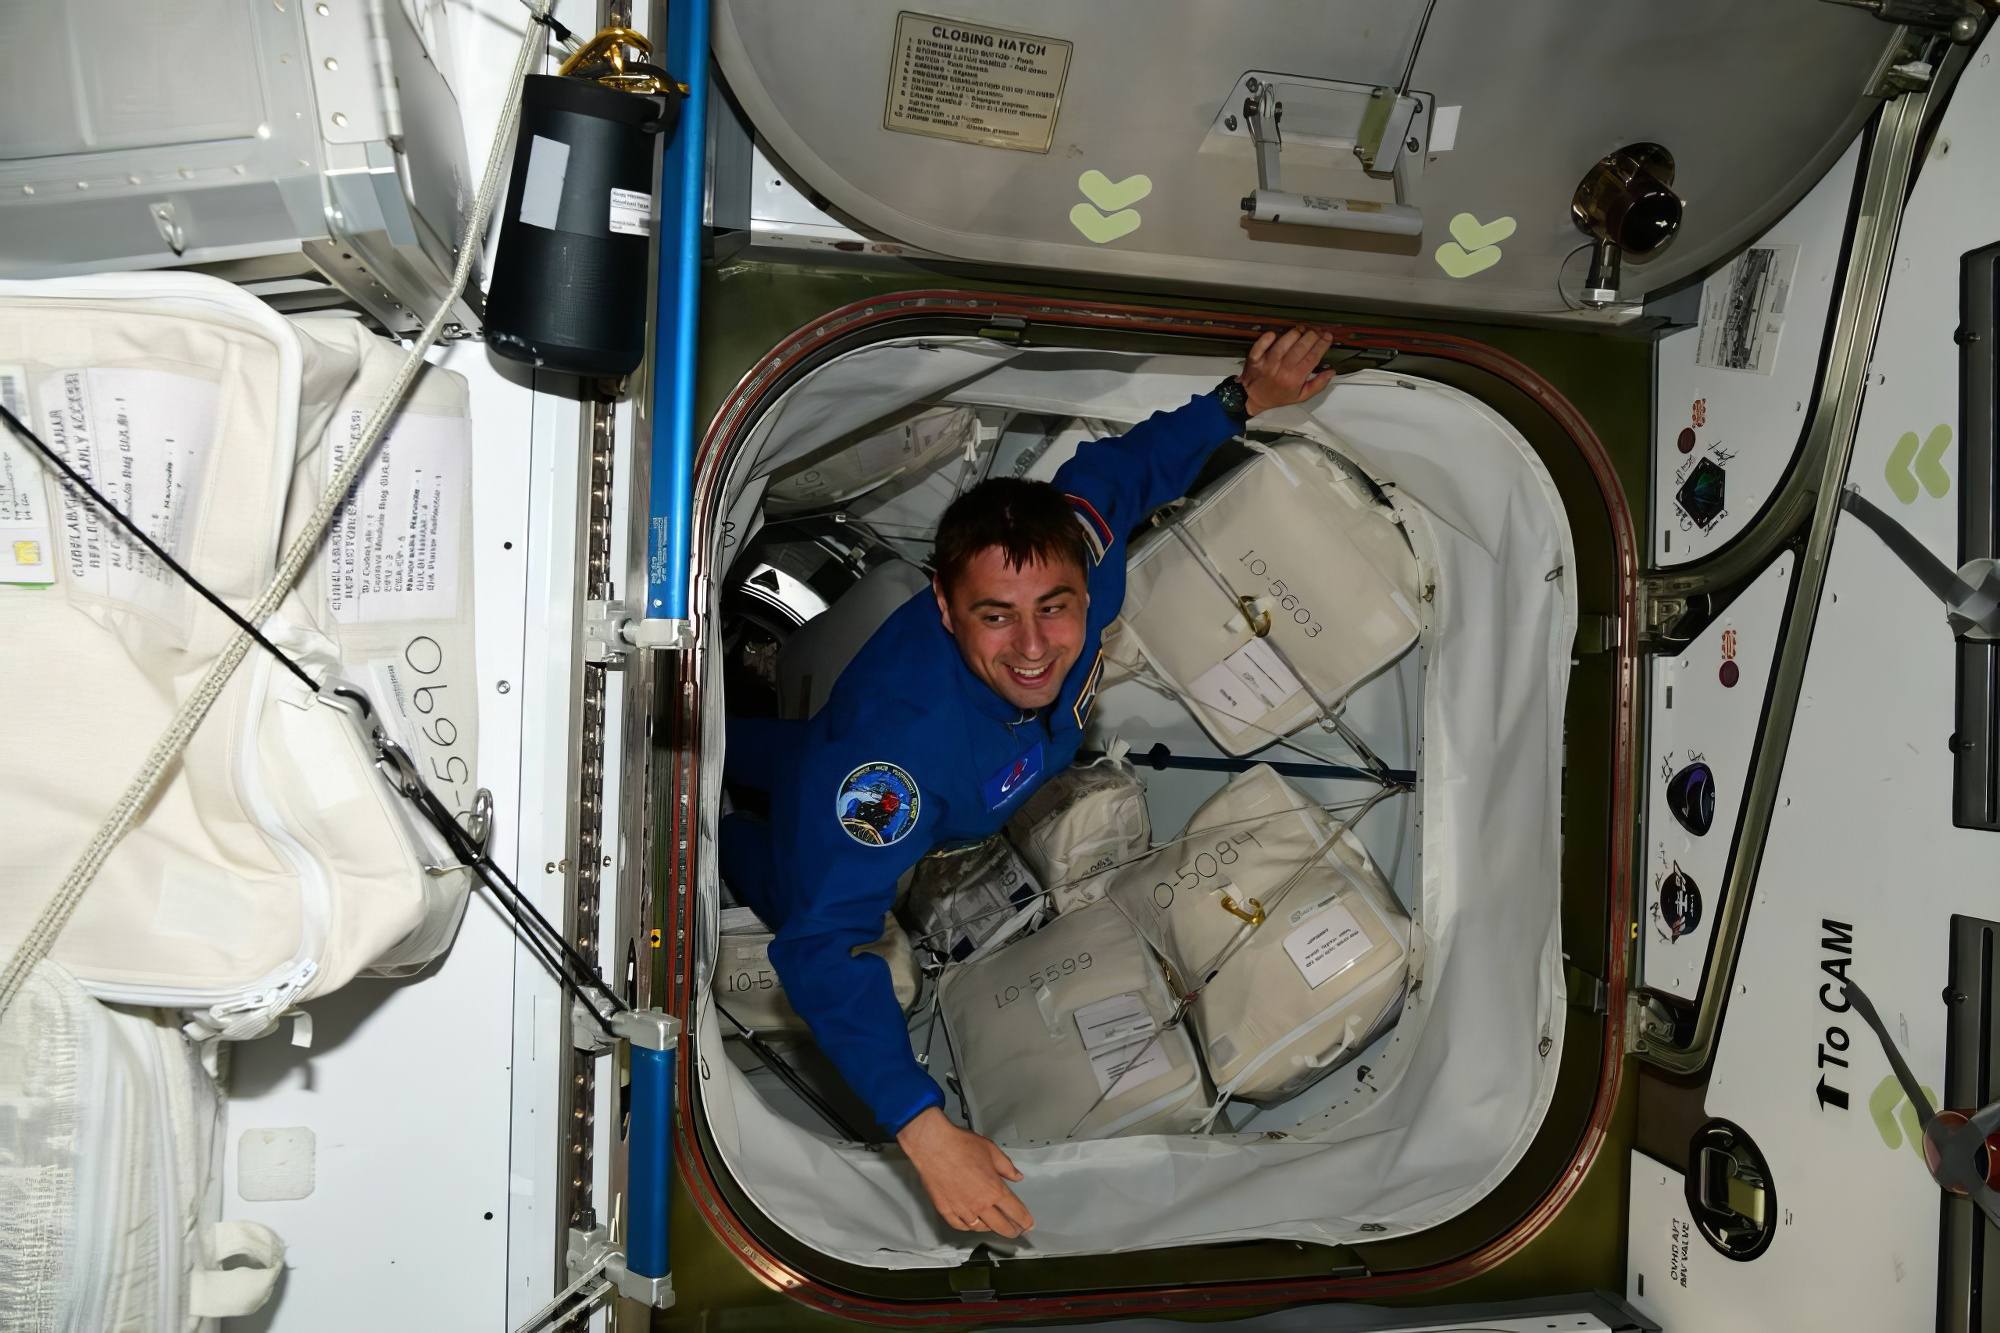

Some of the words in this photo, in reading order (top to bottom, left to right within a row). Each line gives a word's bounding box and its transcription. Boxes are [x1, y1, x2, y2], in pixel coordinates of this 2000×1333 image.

[932, 25, 994, 49] CLOSING
[998, 38, 1047, 57] HATCH
[406, 635, 470, 816] -5690
[729, 970, 778, 992] 10-5
[1818, 917, 1854, 1013] CAM
[1817, 1026, 1851, 1070] To
